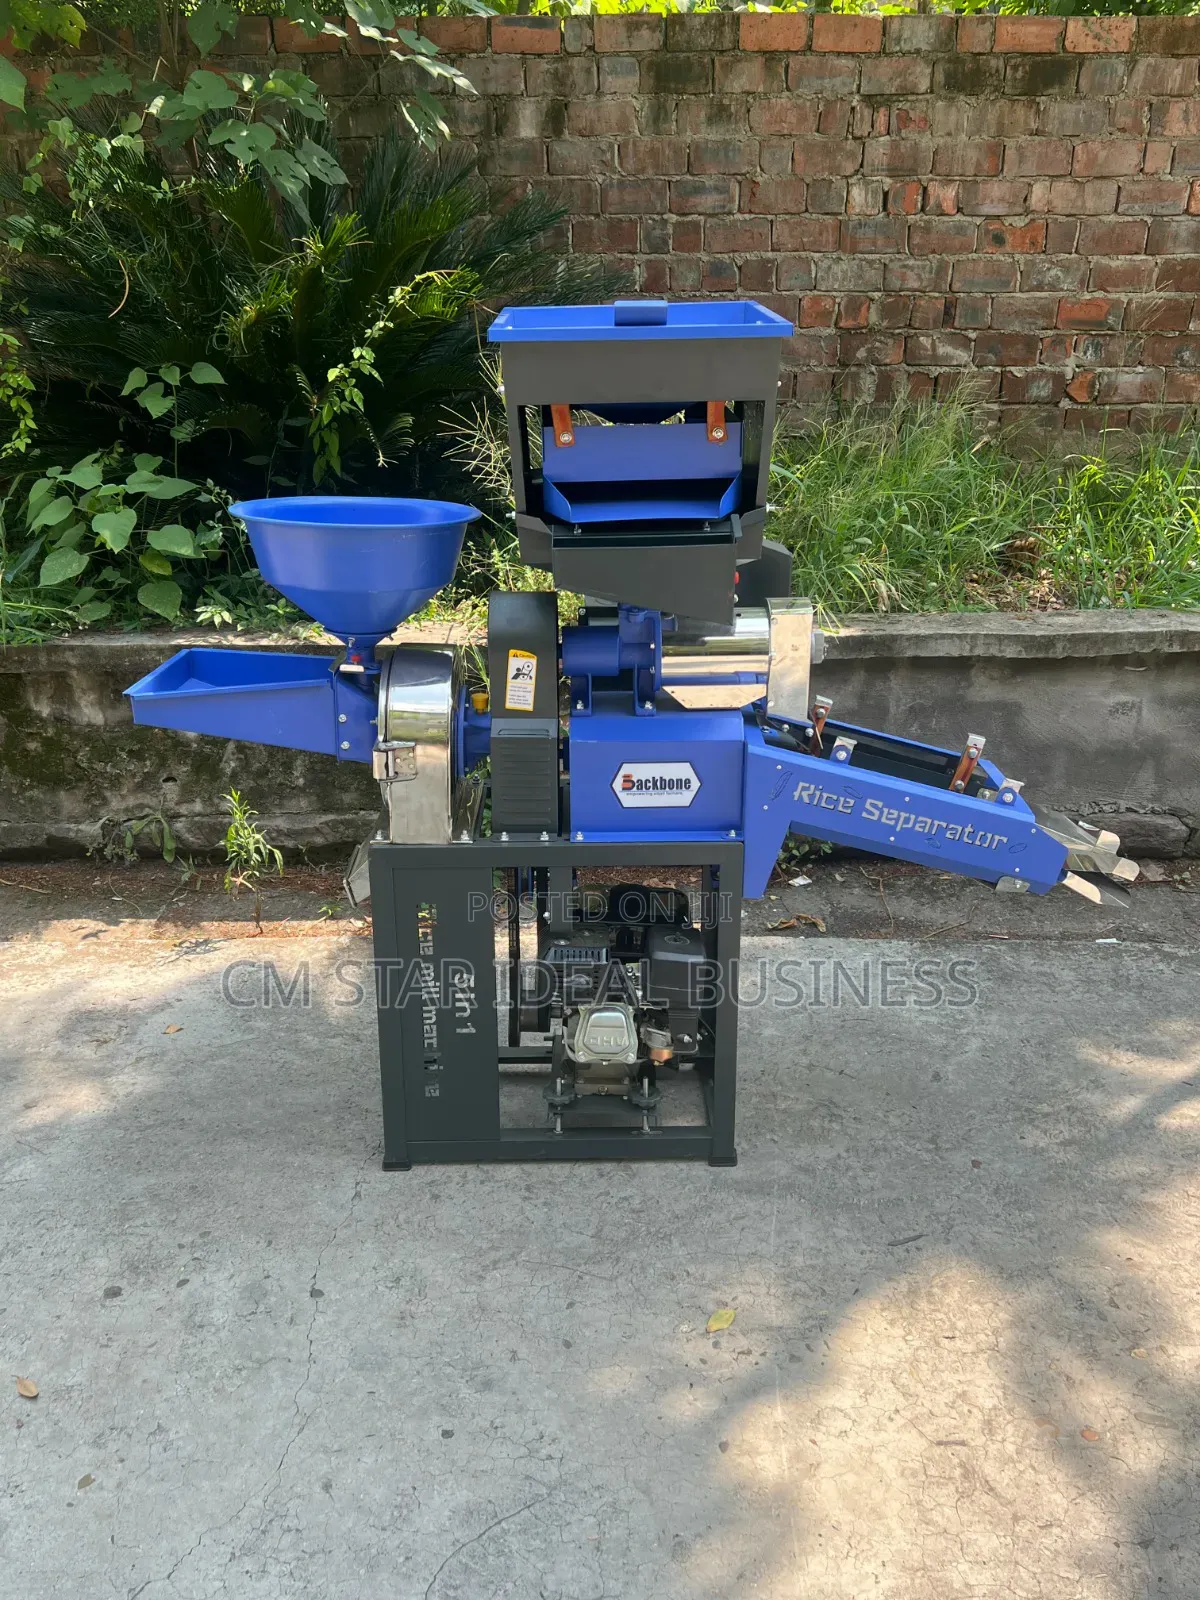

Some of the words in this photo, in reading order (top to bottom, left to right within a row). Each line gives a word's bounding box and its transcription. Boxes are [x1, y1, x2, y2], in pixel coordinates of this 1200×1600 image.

[621, 774, 692, 791] Backbone
[793, 781, 856, 815] Rice
[861, 797, 1009, 850] Separator
[454, 972, 475, 988] 5
[455, 993, 475, 1018] in
[455, 1022, 476, 1034] 1
[422, 1006, 444, 1097] machie
